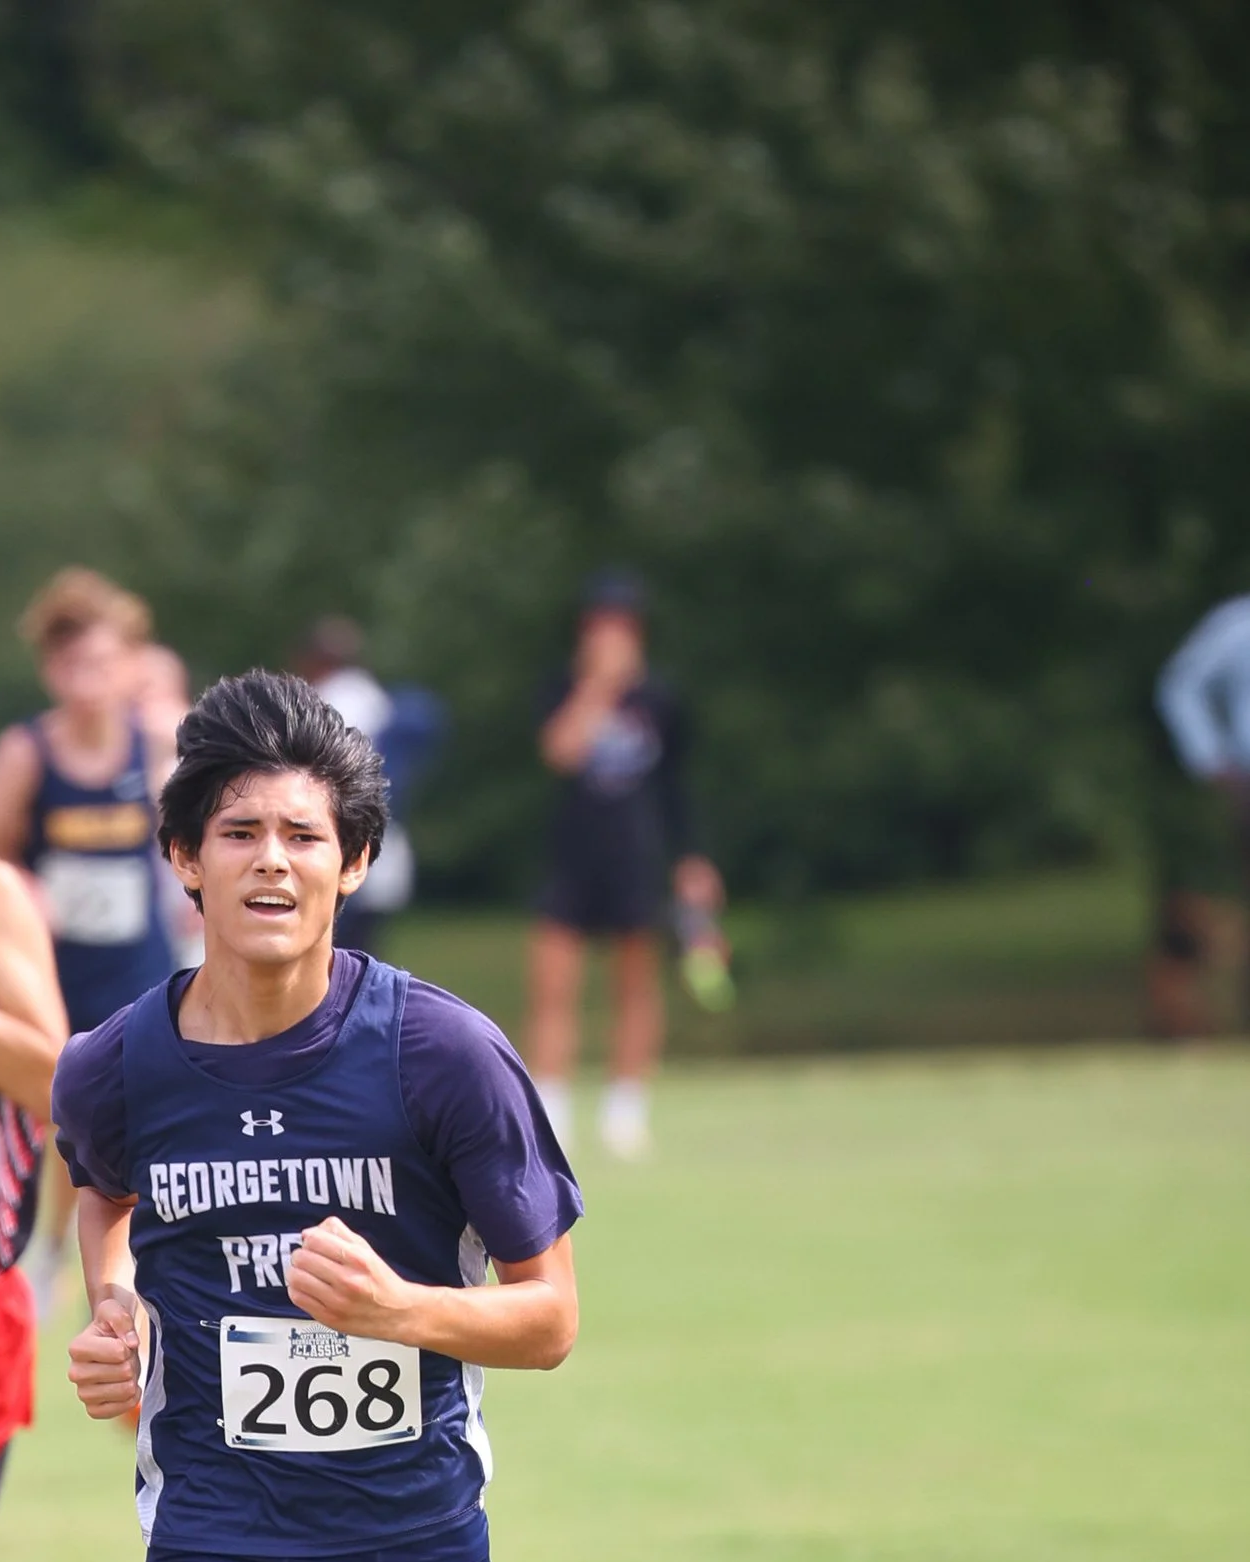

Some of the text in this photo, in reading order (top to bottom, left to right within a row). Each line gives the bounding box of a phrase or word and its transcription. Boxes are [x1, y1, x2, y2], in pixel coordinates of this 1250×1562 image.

[149, 1156, 397, 1224] GEORGETOWN
[216, 1232, 304, 1294] PRE
[296, 1344, 344, 1357] CLASSIC
[240, 1359, 406, 1437] 268
